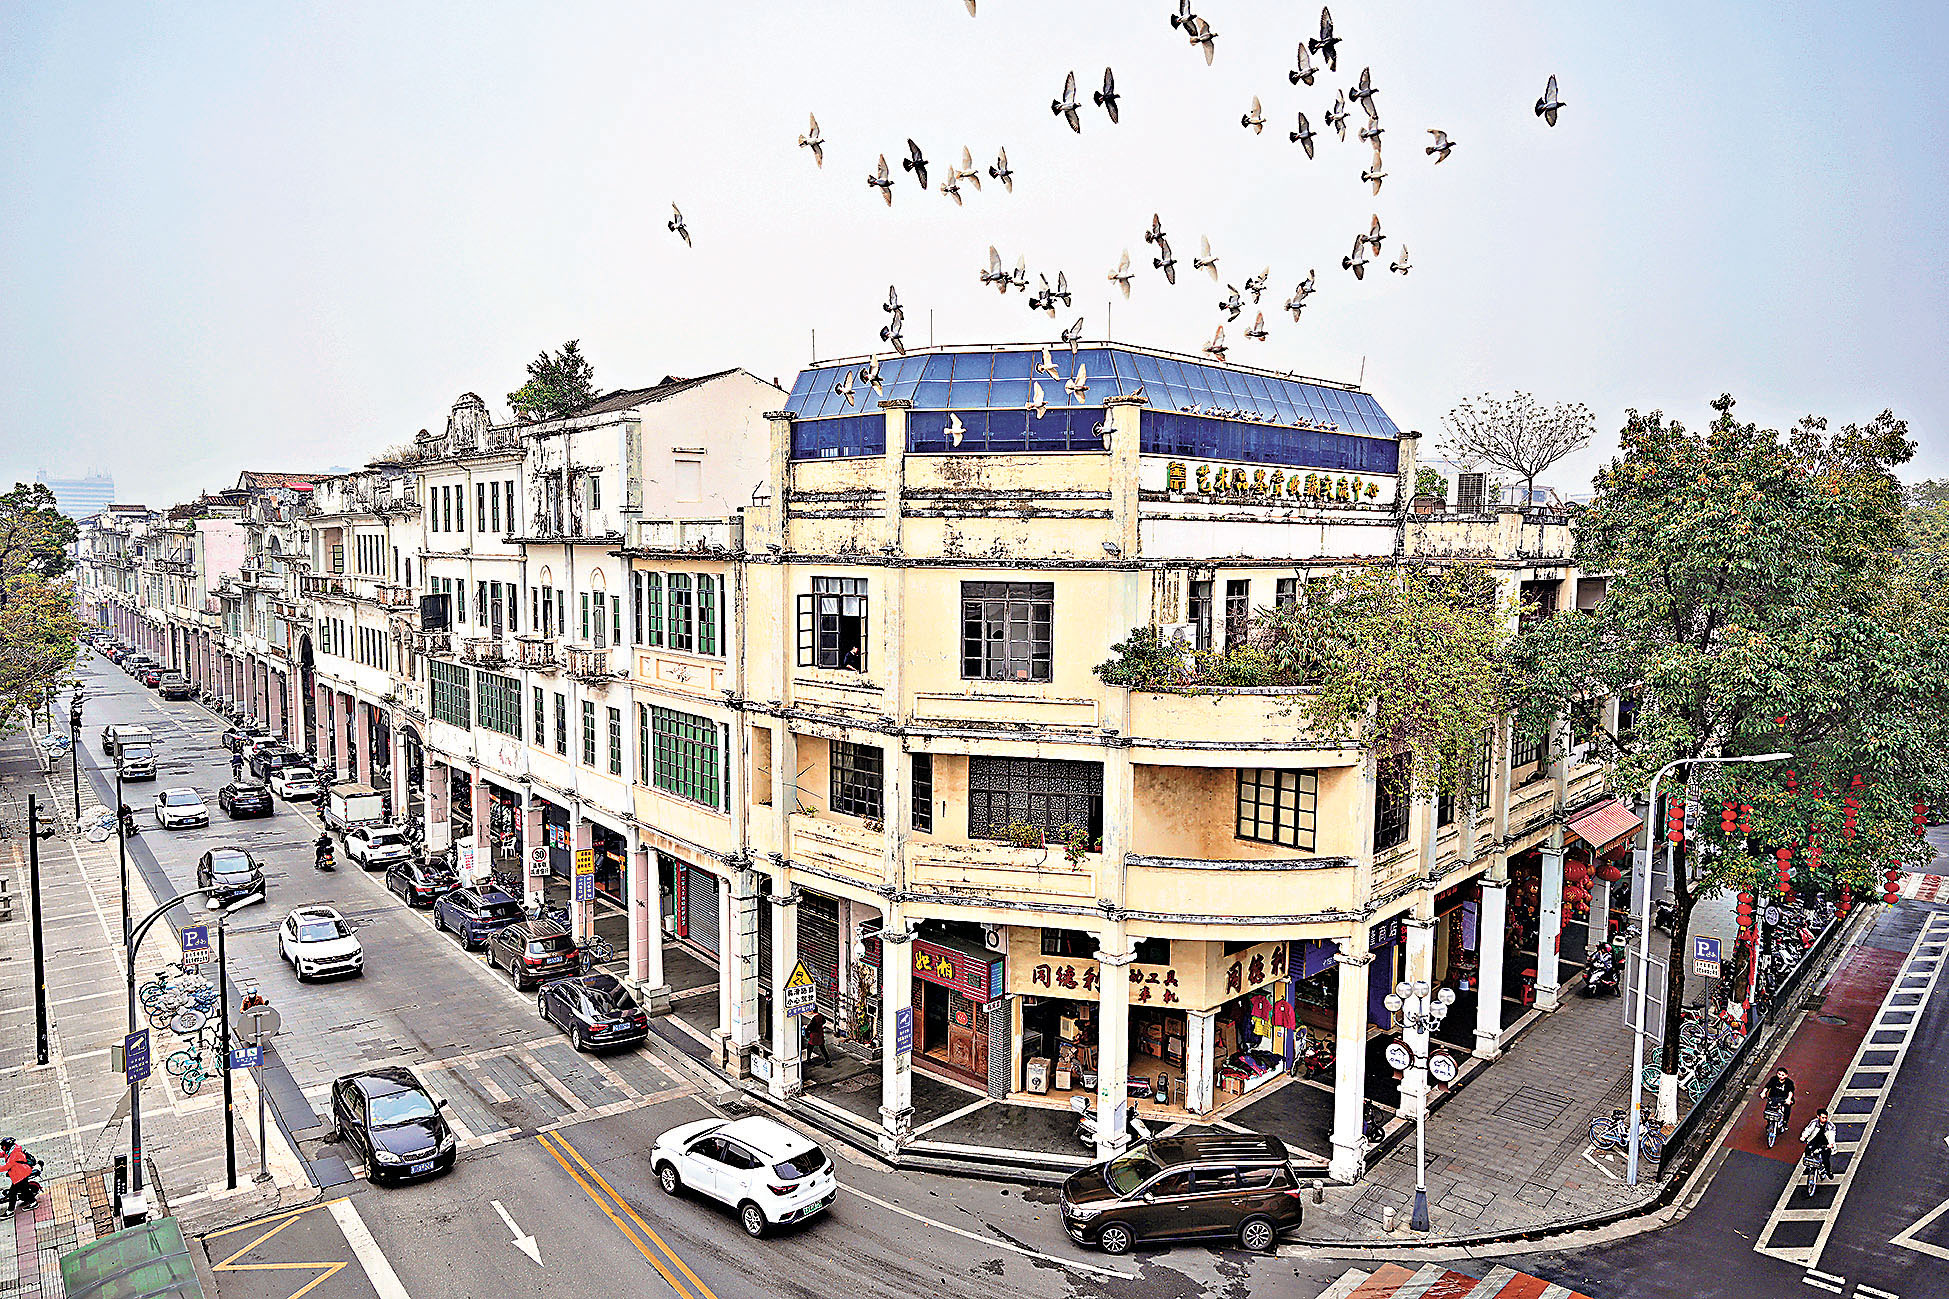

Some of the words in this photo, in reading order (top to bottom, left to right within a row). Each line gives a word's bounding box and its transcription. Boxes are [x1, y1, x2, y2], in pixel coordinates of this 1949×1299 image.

[535, 851, 544, 859] 30
[184, 931, 199, 947] P
[1696, 941, 1710, 957] P
[1226, 941, 1287, 994] 同德利
